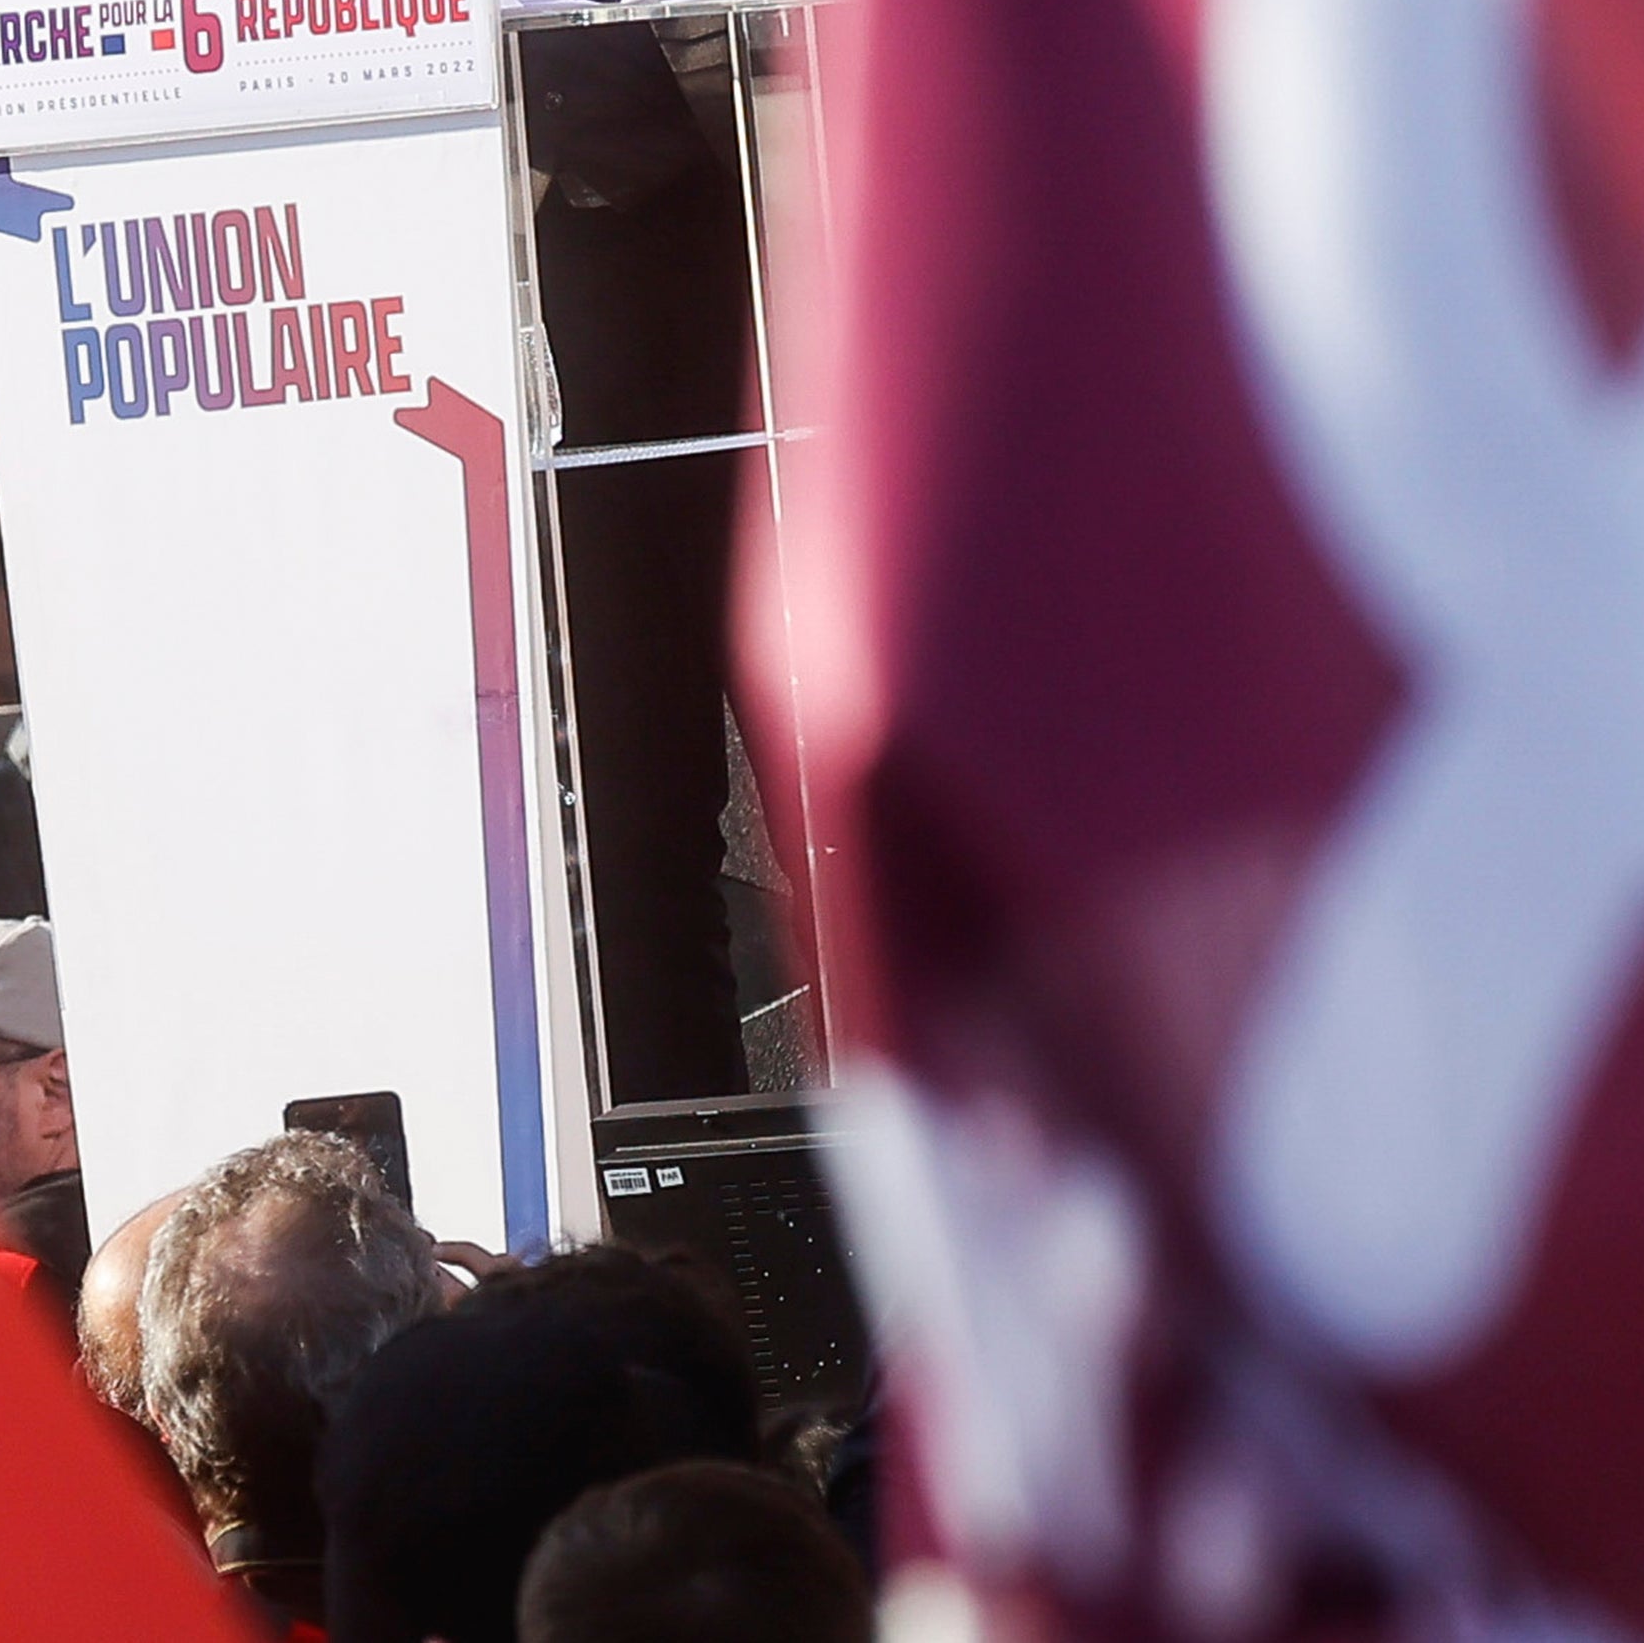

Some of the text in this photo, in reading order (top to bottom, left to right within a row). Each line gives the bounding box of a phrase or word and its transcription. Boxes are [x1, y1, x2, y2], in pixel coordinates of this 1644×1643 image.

[36, 86, 183, 113] PRÉSIDENTIELLE
[239, 75, 295, 92] PARIS
[327, 71, 349, 85] 20
[362, 65, 413, 81] MARS
[426, 59, 476, 76] 2022
[51, 202, 307, 324] L'UNION
[61, 295, 413, 426] POPULAIRE
